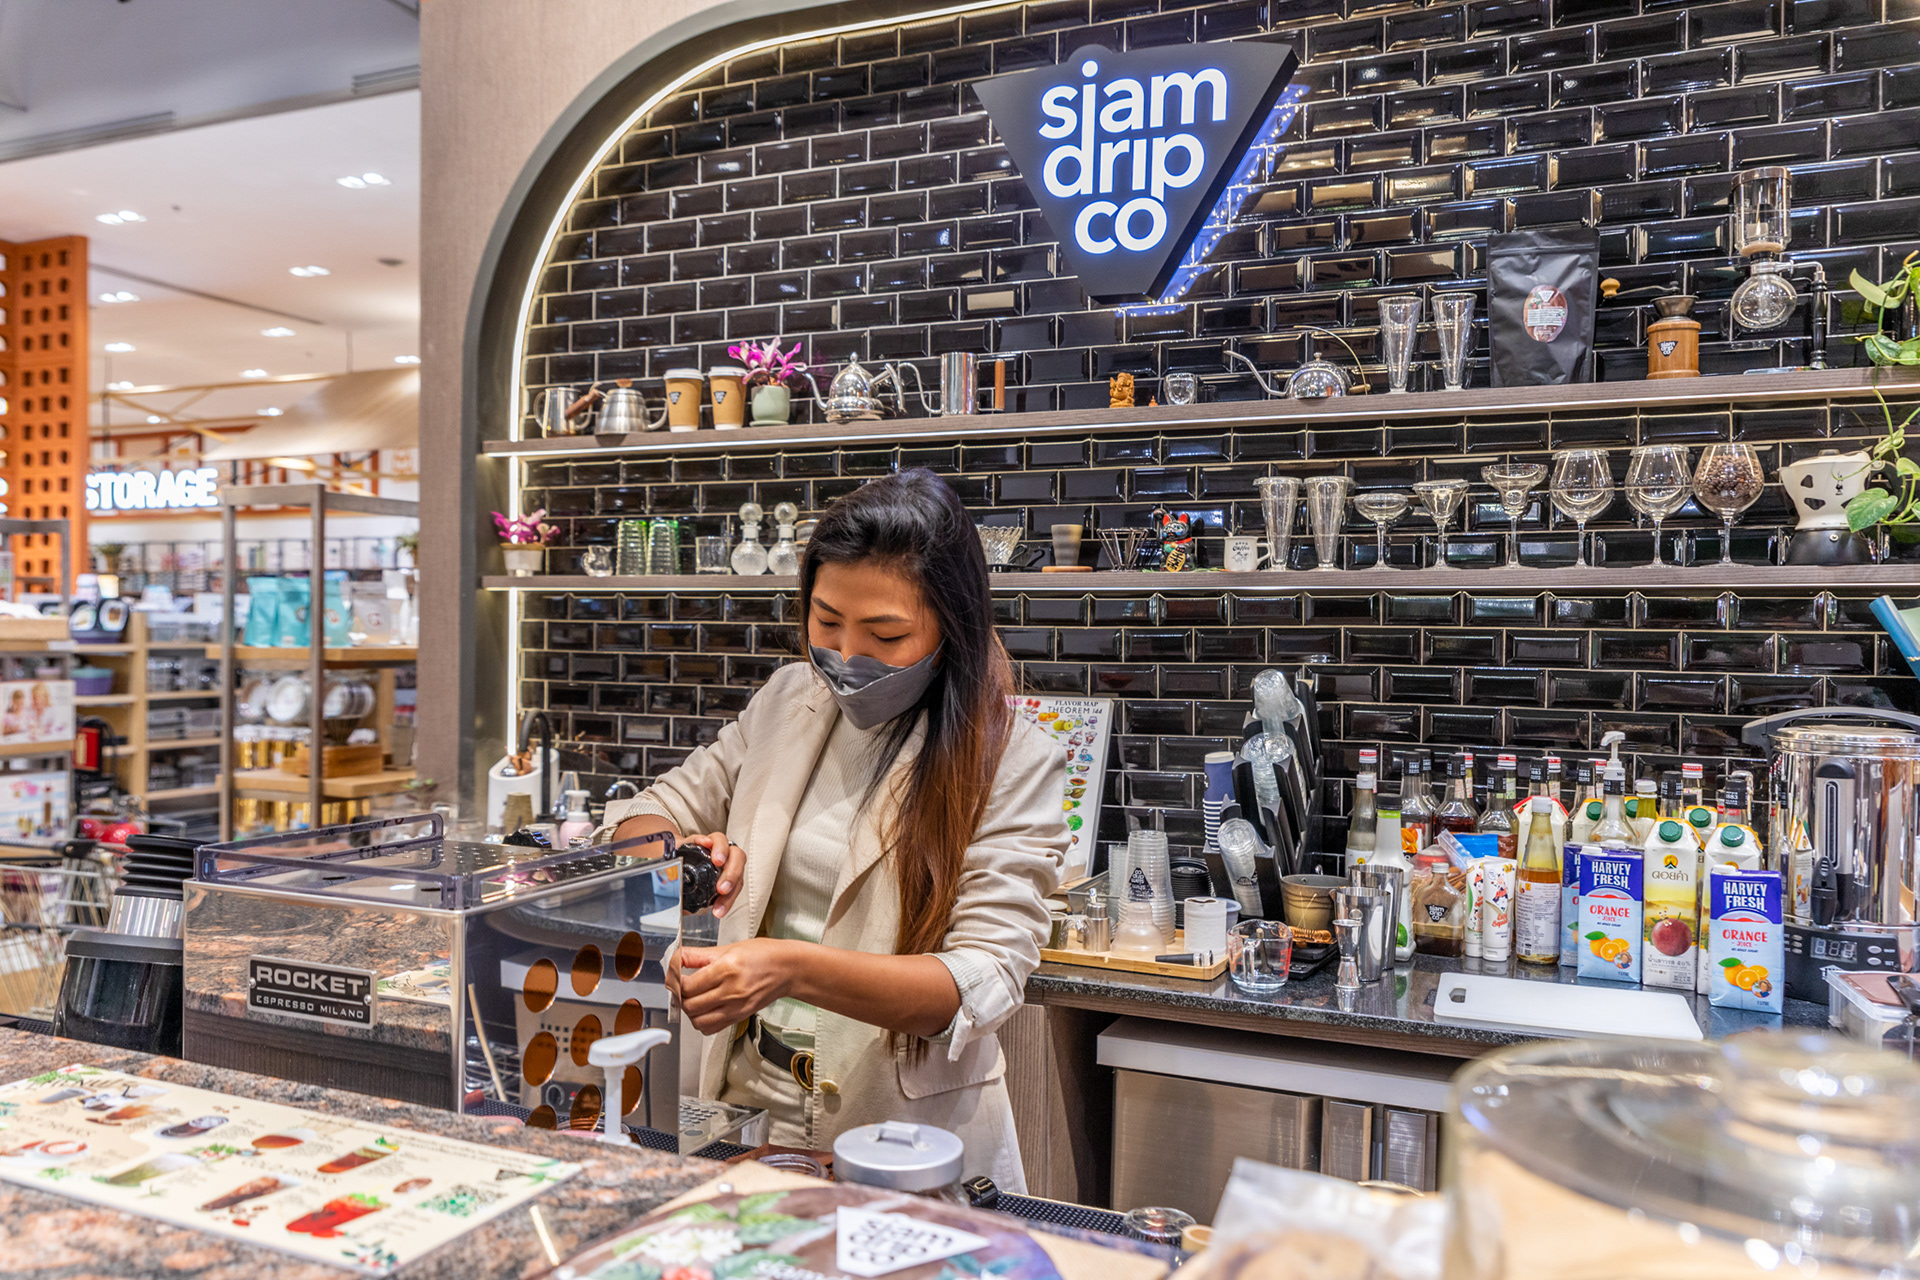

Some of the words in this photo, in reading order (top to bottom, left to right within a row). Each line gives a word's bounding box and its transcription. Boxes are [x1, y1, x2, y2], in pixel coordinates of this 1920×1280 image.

[1038, 60, 1227, 140] siam
[1043, 133, 1205, 202] drip
[1074, 197, 1168, 254] co
[85, 467, 219, 510] STORAGE
[1047, 706, 1090, 714] THEOREM
[1591, 861, 1632, 876] HARVEY
[1723, 881, 1768, 897] HARVEY
[1589, 905, 1630, 918] ORANGE
[1722, 929, 1768, 943] ORANGE
[256, 965, 363, 996] ROCKET
[256, 995, 314, 1012] ESPRESSO
[320, 1005, 364, 1019] MILANO
